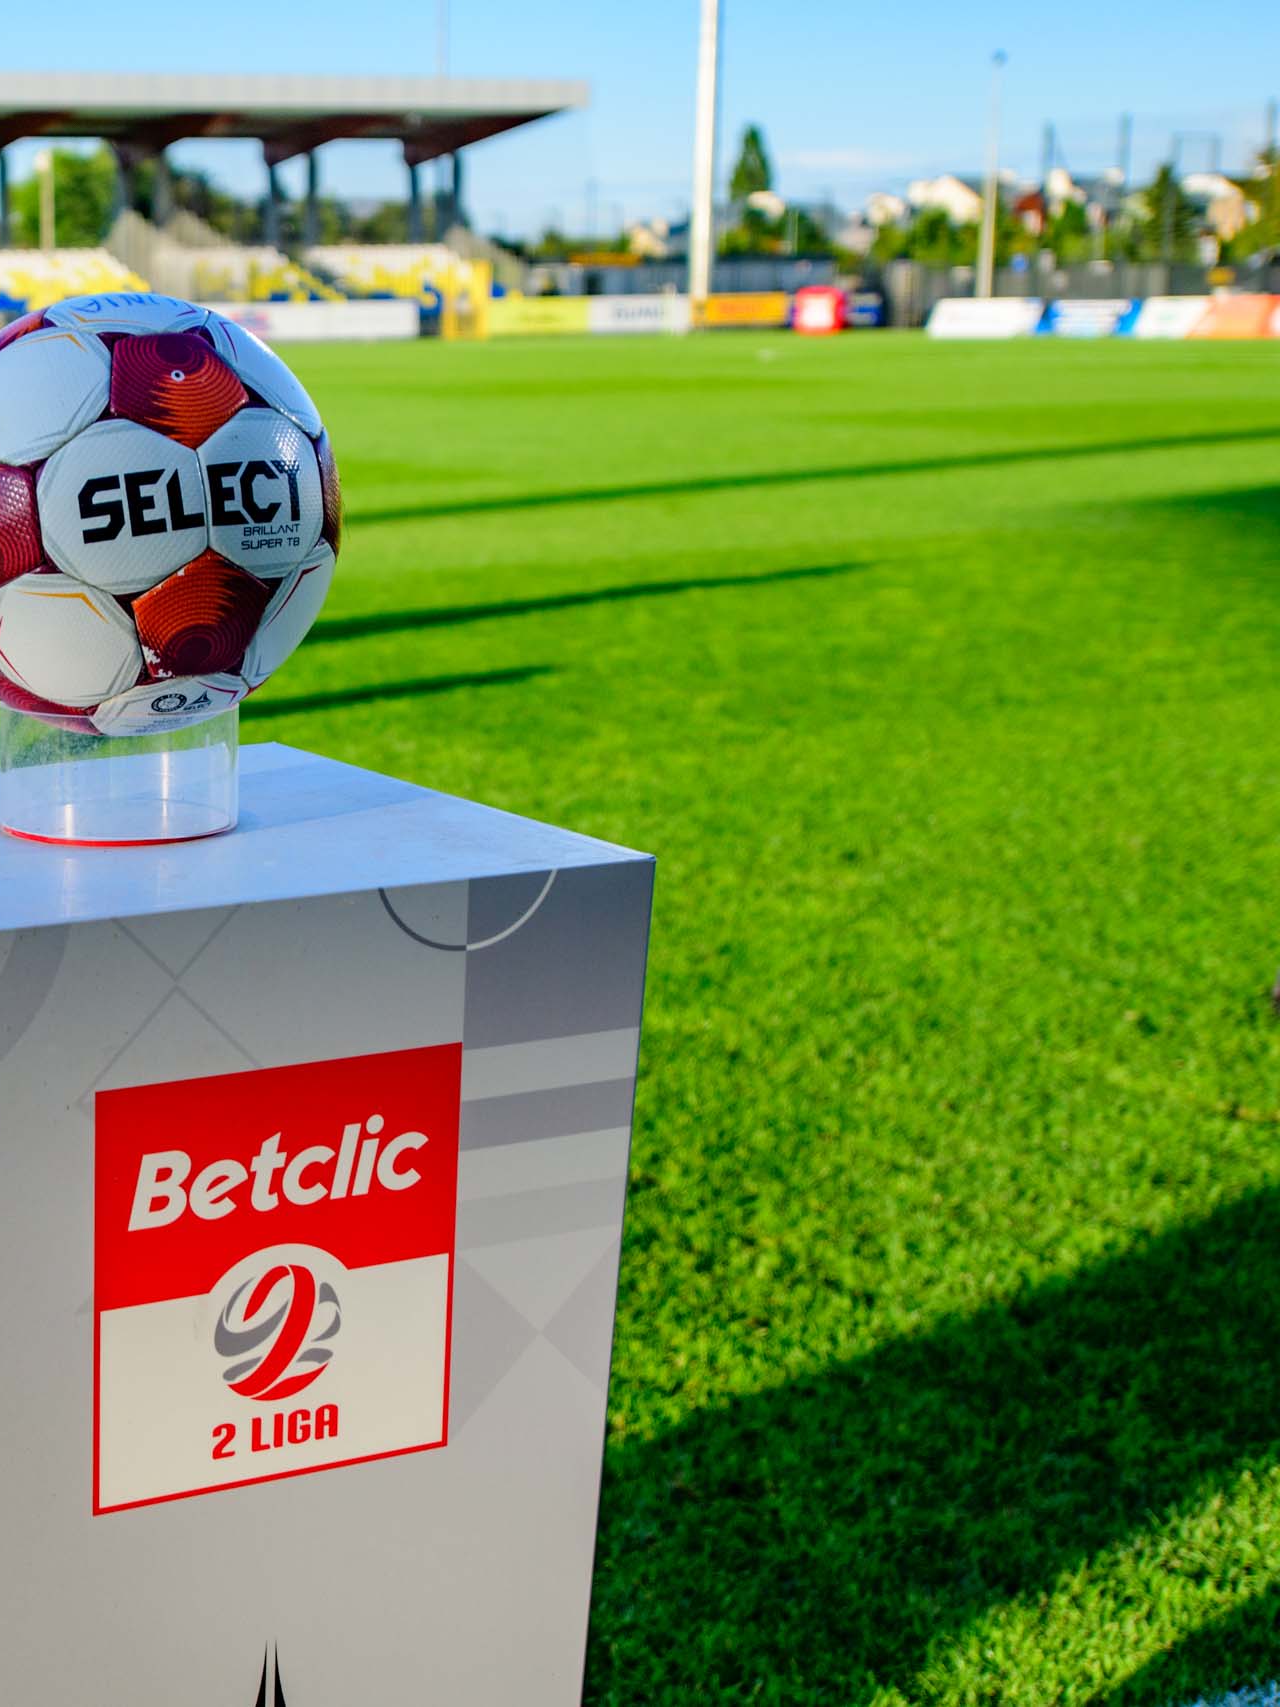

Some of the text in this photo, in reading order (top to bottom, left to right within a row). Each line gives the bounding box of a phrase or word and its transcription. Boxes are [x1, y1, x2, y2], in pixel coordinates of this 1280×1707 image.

[78, 460, 301, 544] SELECT
[241, 539, 282, 551] SUPER
[243, 524, 301, 537] BRILLANT
[128, 1114, 429, 1232] Betclic
[211, 1404, 339, 1460] 2 LIGA
